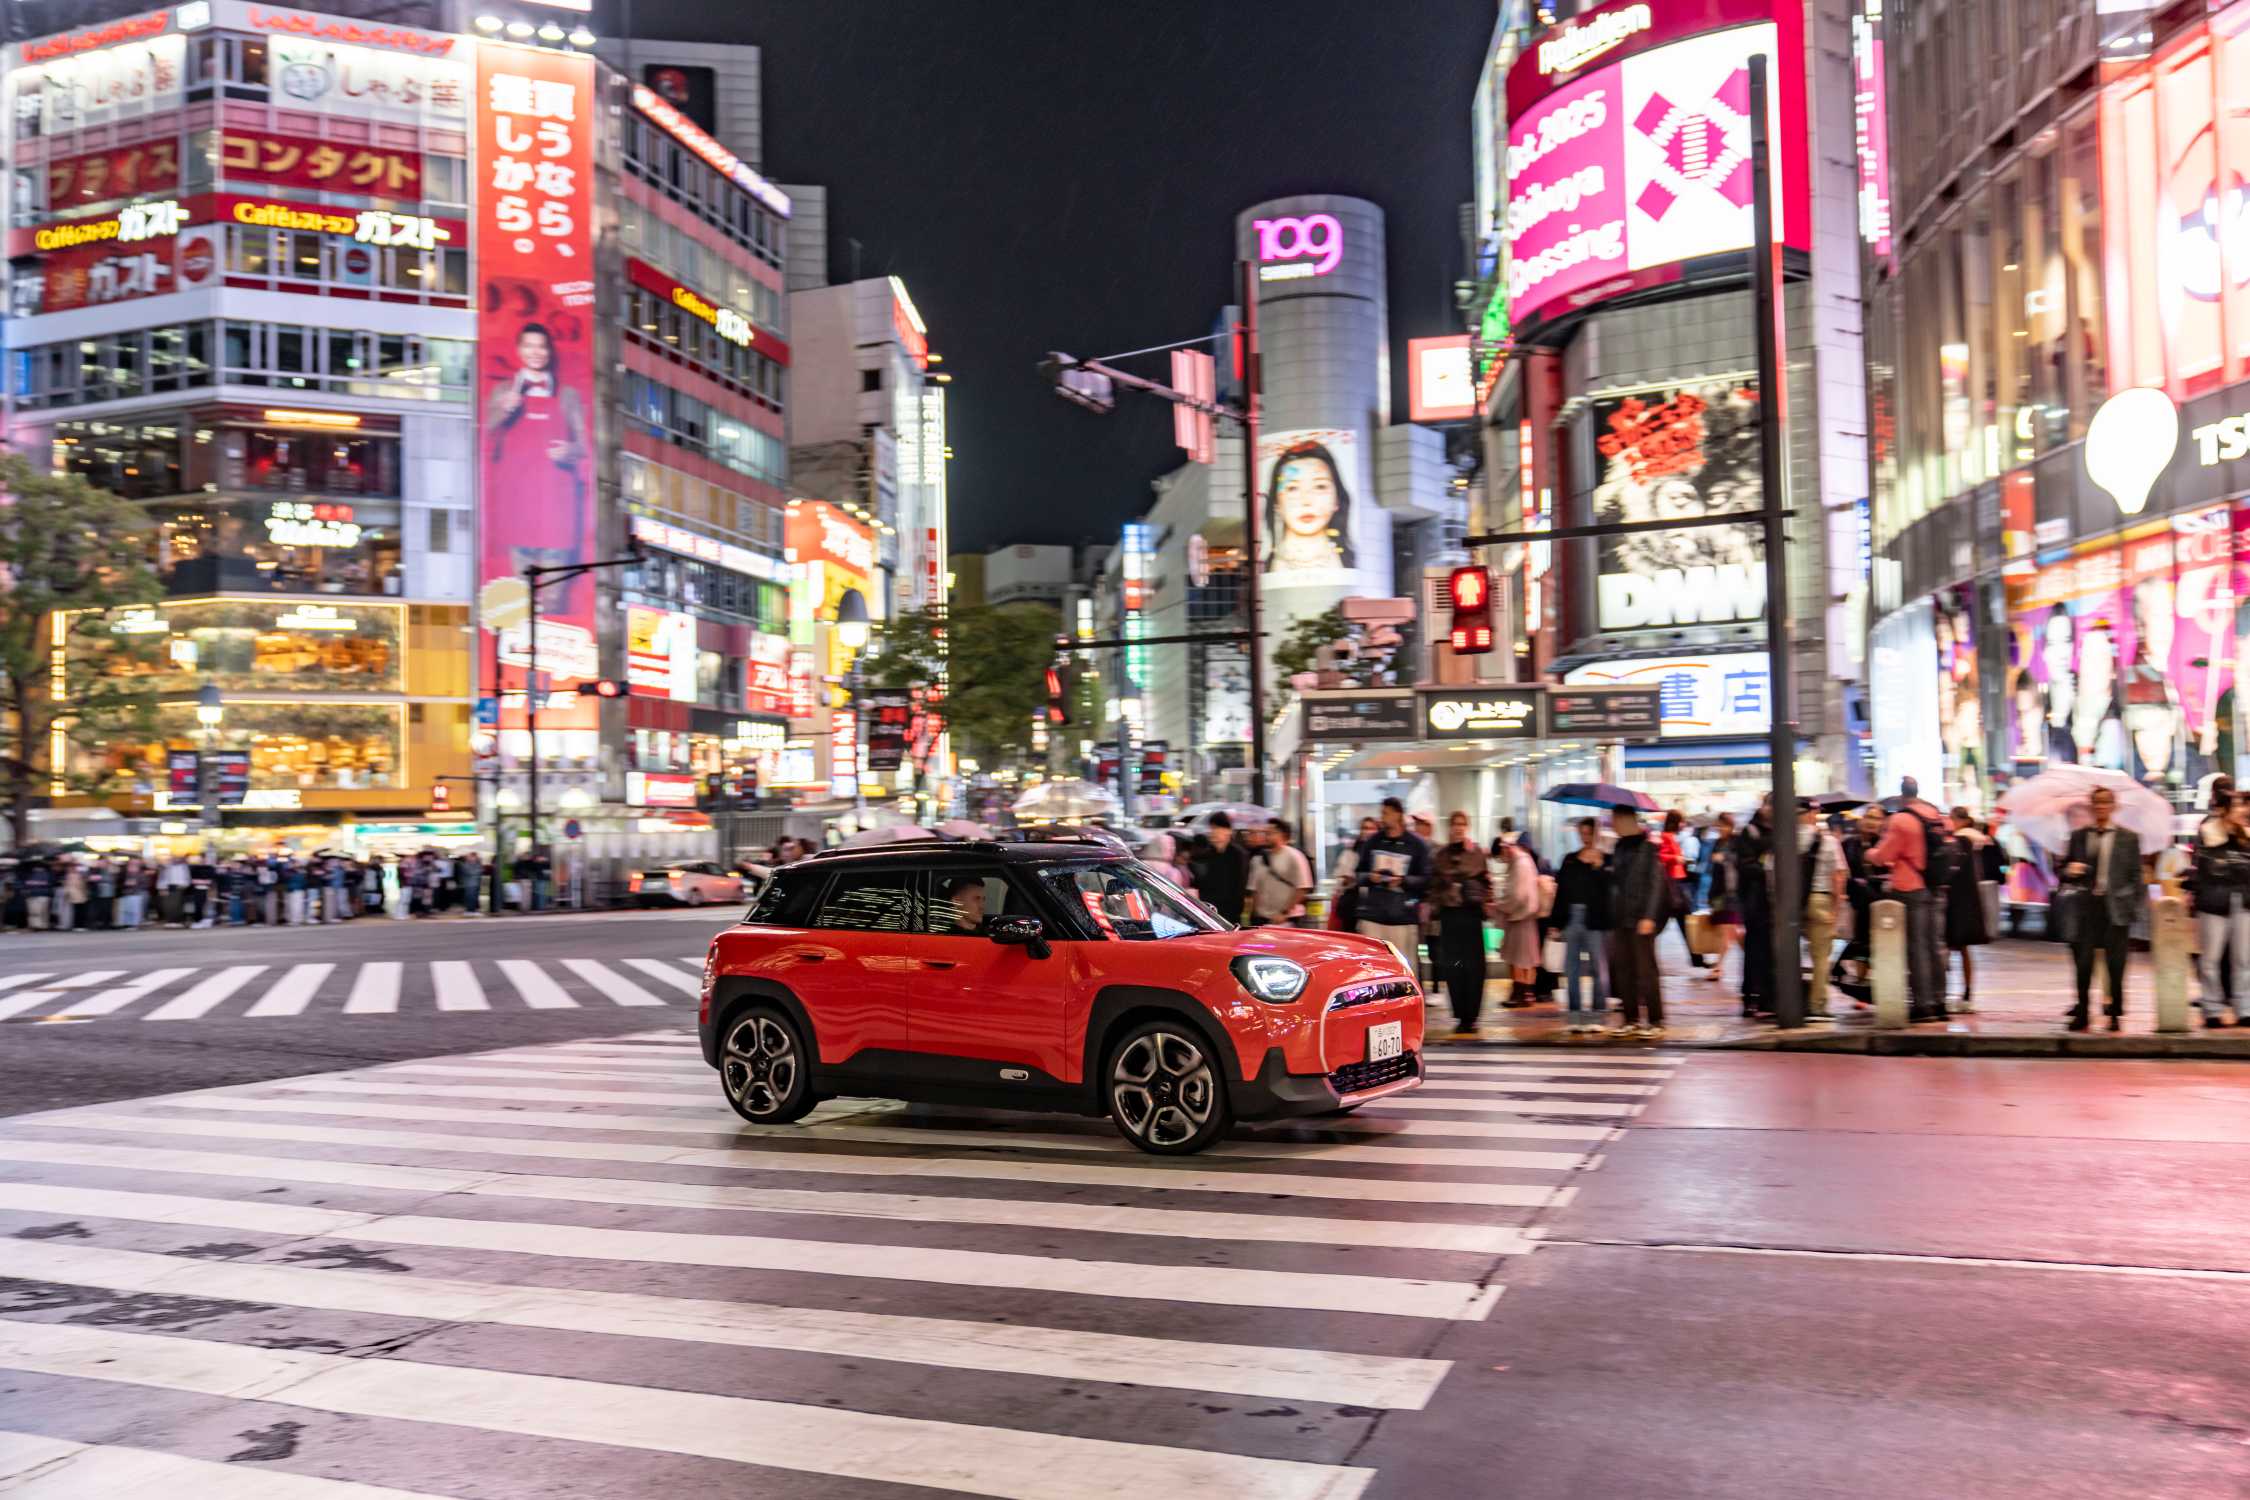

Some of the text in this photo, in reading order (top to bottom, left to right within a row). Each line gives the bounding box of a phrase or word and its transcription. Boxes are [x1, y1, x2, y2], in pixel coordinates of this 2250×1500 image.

[223, 136, 420, 190] コンタクト
[533, 79, 576, 257] 買うなら、
[355, 210, 450, 250] ガスト
[1252, 213, 1344, 276] 109
[2192, 411, 2250, 467] TS
